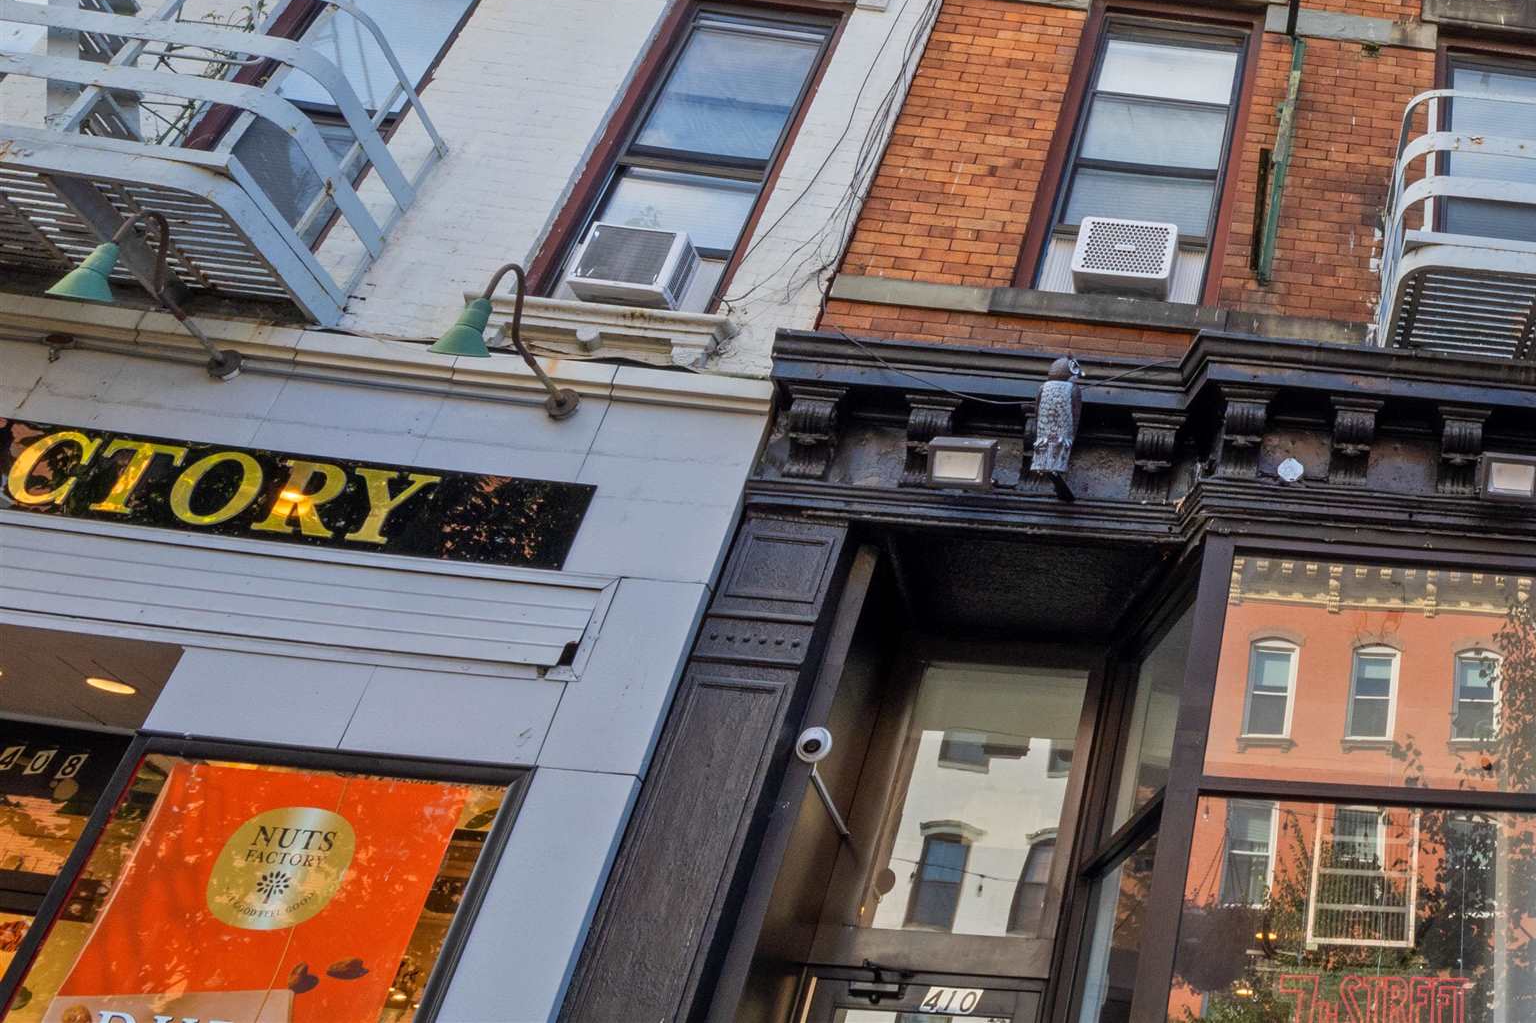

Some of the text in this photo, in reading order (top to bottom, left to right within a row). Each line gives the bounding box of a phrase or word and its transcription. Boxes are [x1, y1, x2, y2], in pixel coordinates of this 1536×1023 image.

[0, 747, 83, 776] 408
[251, 825, 337, 852] NUTS
[245, 849, 328, 867] FACTORY
[923, 990, 978, 1012] 410
